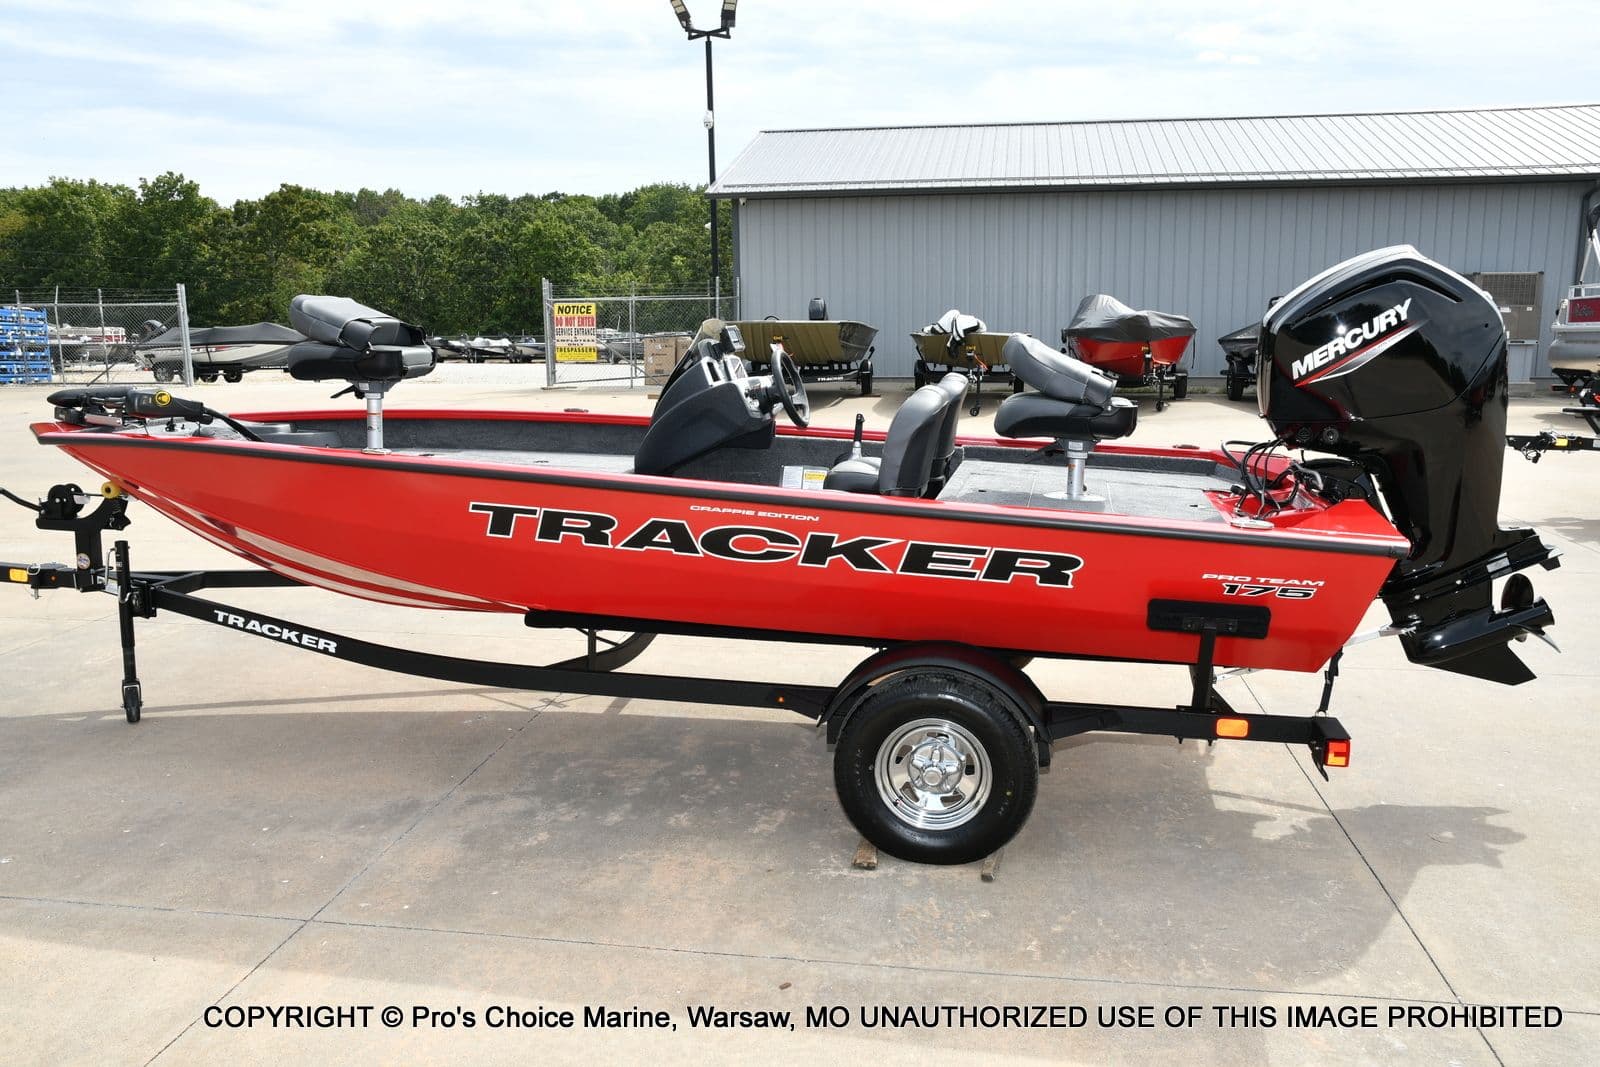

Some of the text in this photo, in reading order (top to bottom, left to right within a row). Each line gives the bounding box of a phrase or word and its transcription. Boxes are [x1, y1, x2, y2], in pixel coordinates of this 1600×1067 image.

[558, 305, 592, 314] NOTICE
[556, 316, 594, 327] DO NOT ENTER
[556, 328, 595, 336] SERVICE ENTRANCE
[1291, 298, 1411, 379] MERCURY
[690, 505, 820, 521] CRAPPIE EDITION
[468, 501, 1085, 589] TRACKER
[1202, 573, 1325, 587] PRO TEAM
[1223, 583, 1317, 600] 175
[214, 609, 338, 654] TRACKER
